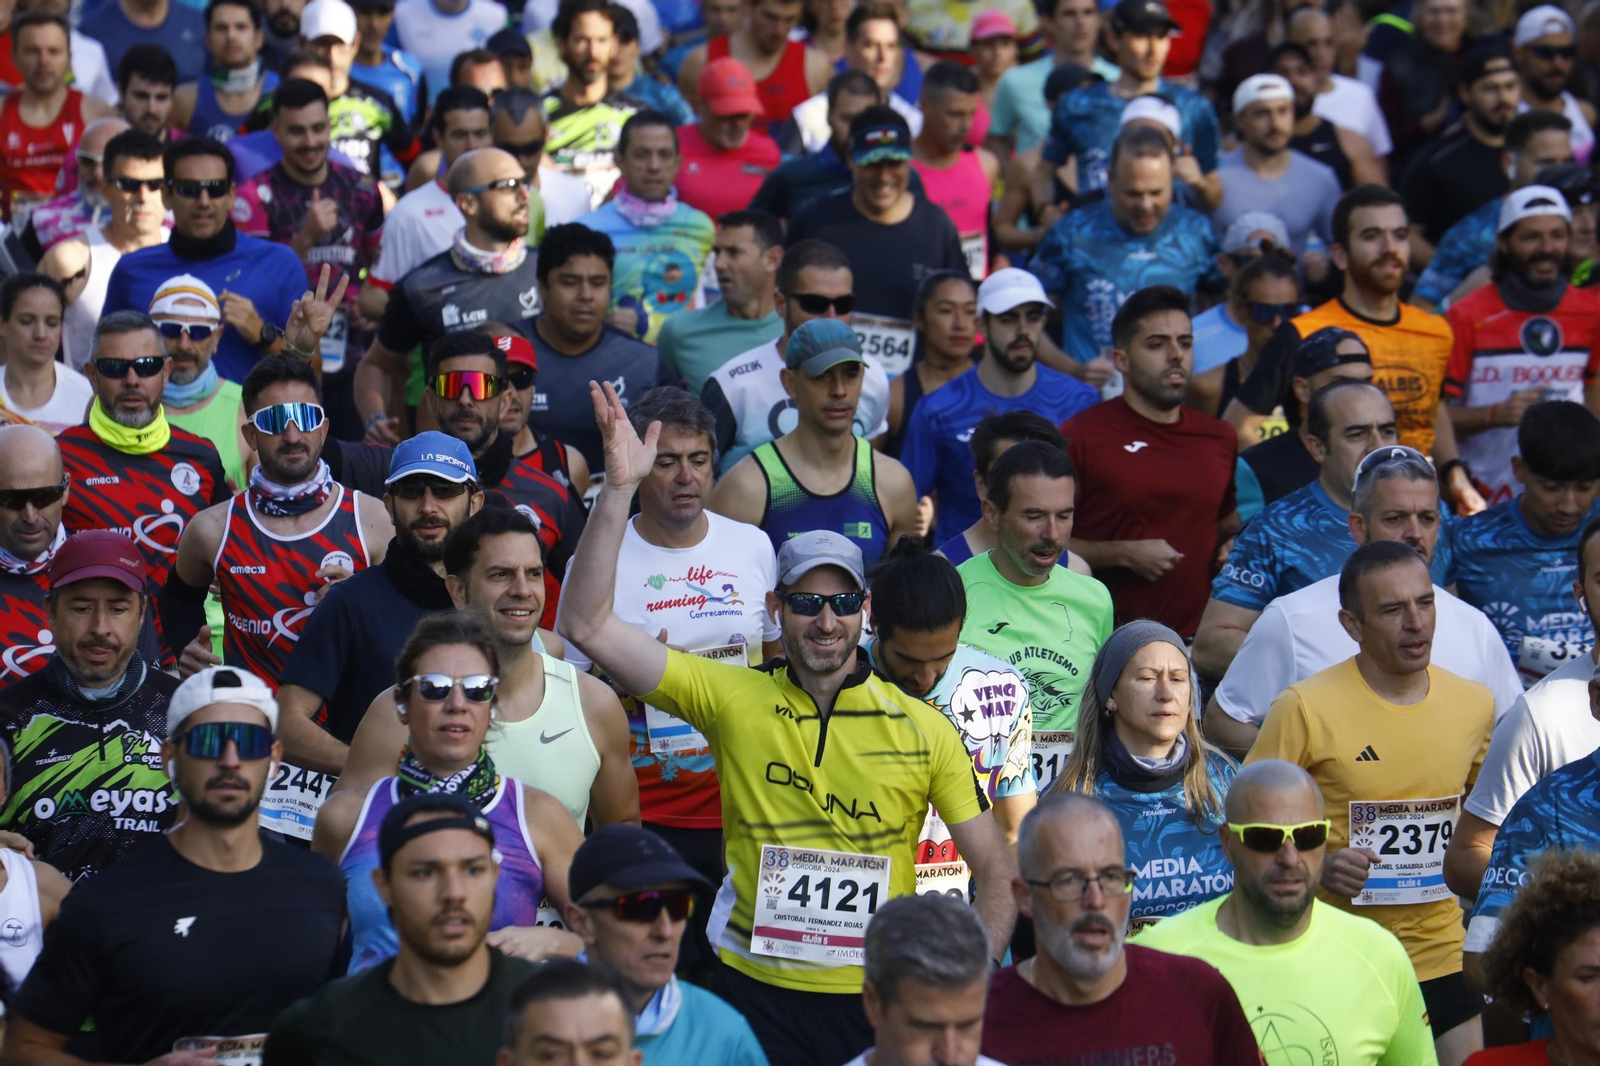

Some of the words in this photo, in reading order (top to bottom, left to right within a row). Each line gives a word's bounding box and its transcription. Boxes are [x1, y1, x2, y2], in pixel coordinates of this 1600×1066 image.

[729, 359, 763, 379] POZIK
[687, 565, 714, 586] life
[646, 594, 708, 613] running
[689, 608, 743, 619] Correcaminos
[1024, 646, 1079, 676] ATLETISMO
[1353, 804, 1377, 821] 38
[1379, 804, 1410, 814] MEDIA
[1415, 798, 1456, 814] MARATÓN
[114, 817, 161, 833] TRAIL
[1379, 820, 1453, 855] 2379
[765, 850, 790, 869] 38
[793, 852, 826, 864] MEDIA
[830, 855, 885, 871] MARATÓN
[1131, 856, 1203, 880] MEDIA
[1395, 862, 1424, 870] SANABRIA
[915, 865, 962, 879] MARATÓN
[787, 874, 879, 915] 4121
[1132, 868, 1235, 902] MARATÓN
[774, 913, 806, 923] CRISTOBAL
[802, 934, 822, 945] CAJÓN
[823, 936, 828, 945] 5
